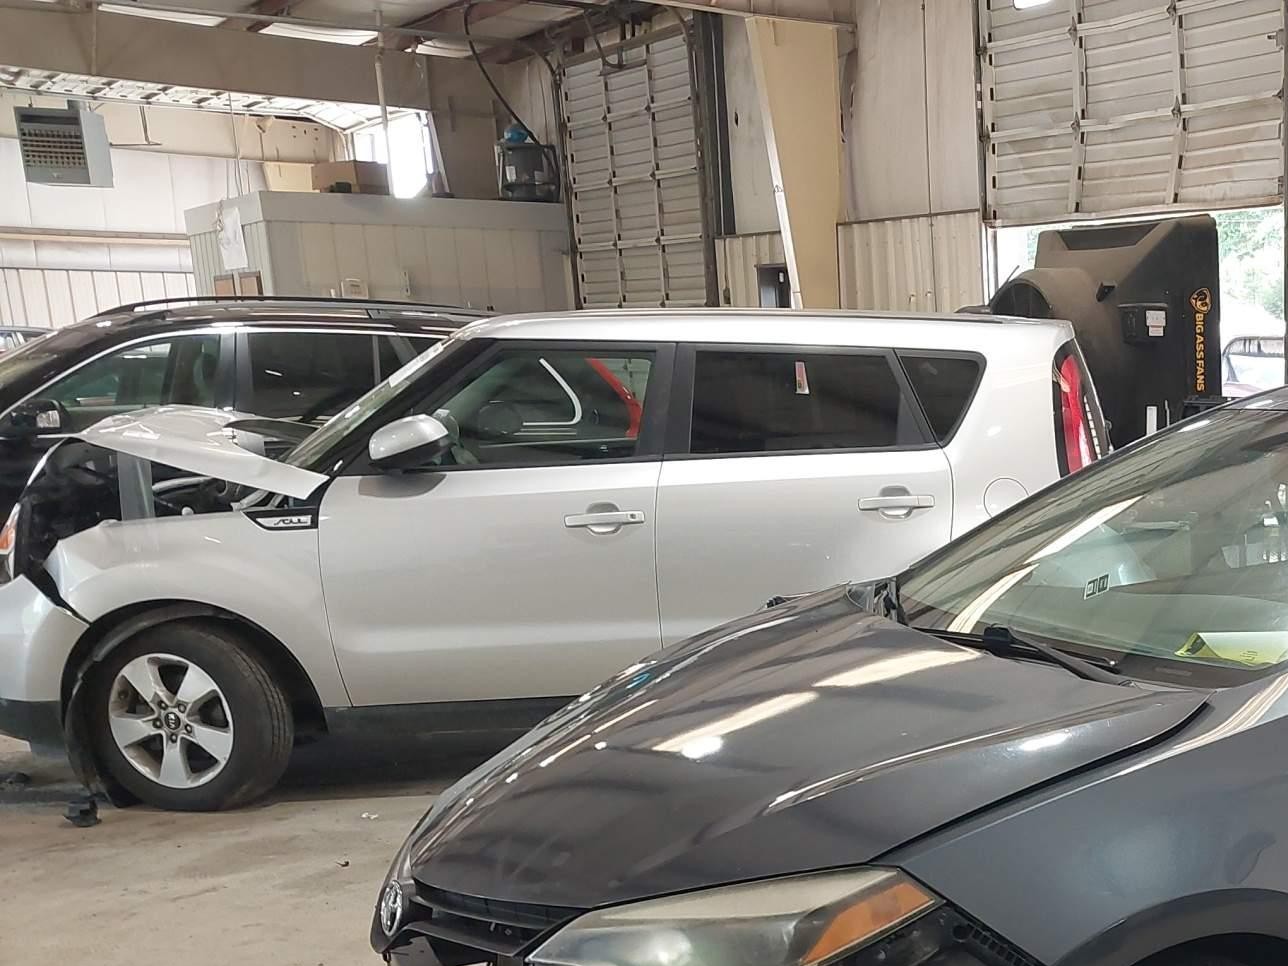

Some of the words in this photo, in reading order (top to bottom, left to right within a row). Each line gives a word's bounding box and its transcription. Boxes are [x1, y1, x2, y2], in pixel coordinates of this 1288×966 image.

[1195, 313, 1204, 333] BIG
[1195, 334, 1205, 359] ASS
[1196, 360, 1205, 391] FANS
